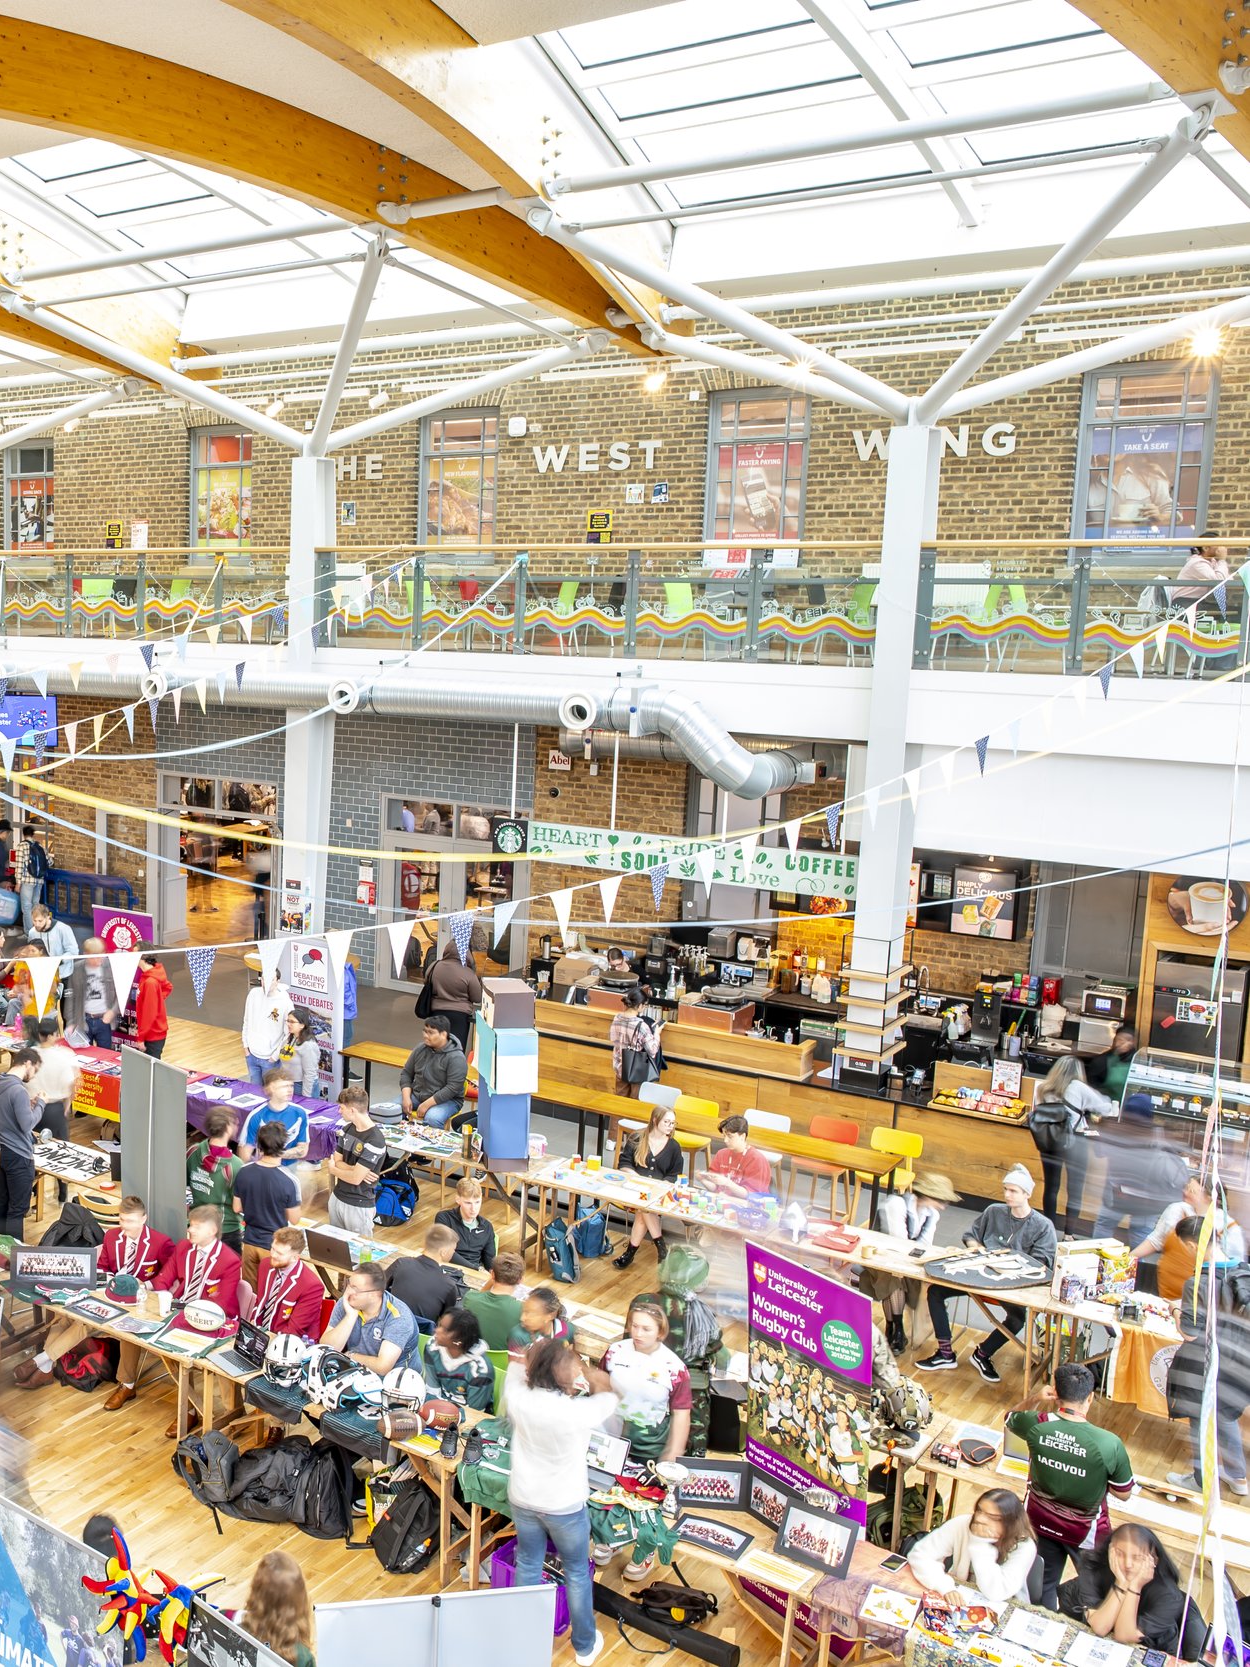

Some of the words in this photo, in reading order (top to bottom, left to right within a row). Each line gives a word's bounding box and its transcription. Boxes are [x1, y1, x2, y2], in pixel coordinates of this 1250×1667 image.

[337, 454, 384, 481] HE
[532, 439, 663, 474] WEST
[852, 422, 1017, 461] WNG
[1123, 443, 1142, 451] TAKE
[1149, 442, 1169, 450] SEAT
[550, 754, 570, 766] Abel
[532, 826, 603, 848] HEART
[784, 853, 855, 878] COFFEE
[956, 880, 983, 889] SIMPLY
[956, 887, 1013, 901] DELICIOUS
[293, 971, 325, 983] DEBATING
[297, 978, 325, 990] SOCIETY
[308, 996, 334, 1011] DEBATES
[74, 1086, 96, 1097] Labour
[74, 1094, 98, 1107] Society
[767, 1268, 808, 1294] University
[809, 1289, 818, 1300] of
[767, 1278, 824, 1314] Leicester
[752, 1292, 806, 1329] Women's
[752, 1308, 789, 1339] Rugby
[791, 1329, 818, 1353] Club
[829, 1325, 852, 1339] Team
[823, 1332, 860, 1350] Leicester
[1054, 1430, 1076, 1443] TEAM
[1039, 1436, 1087, 1458] LEICESTER
[748, 1441, 772, 1461] Whether
[792, 1469, 811, 1487] played
